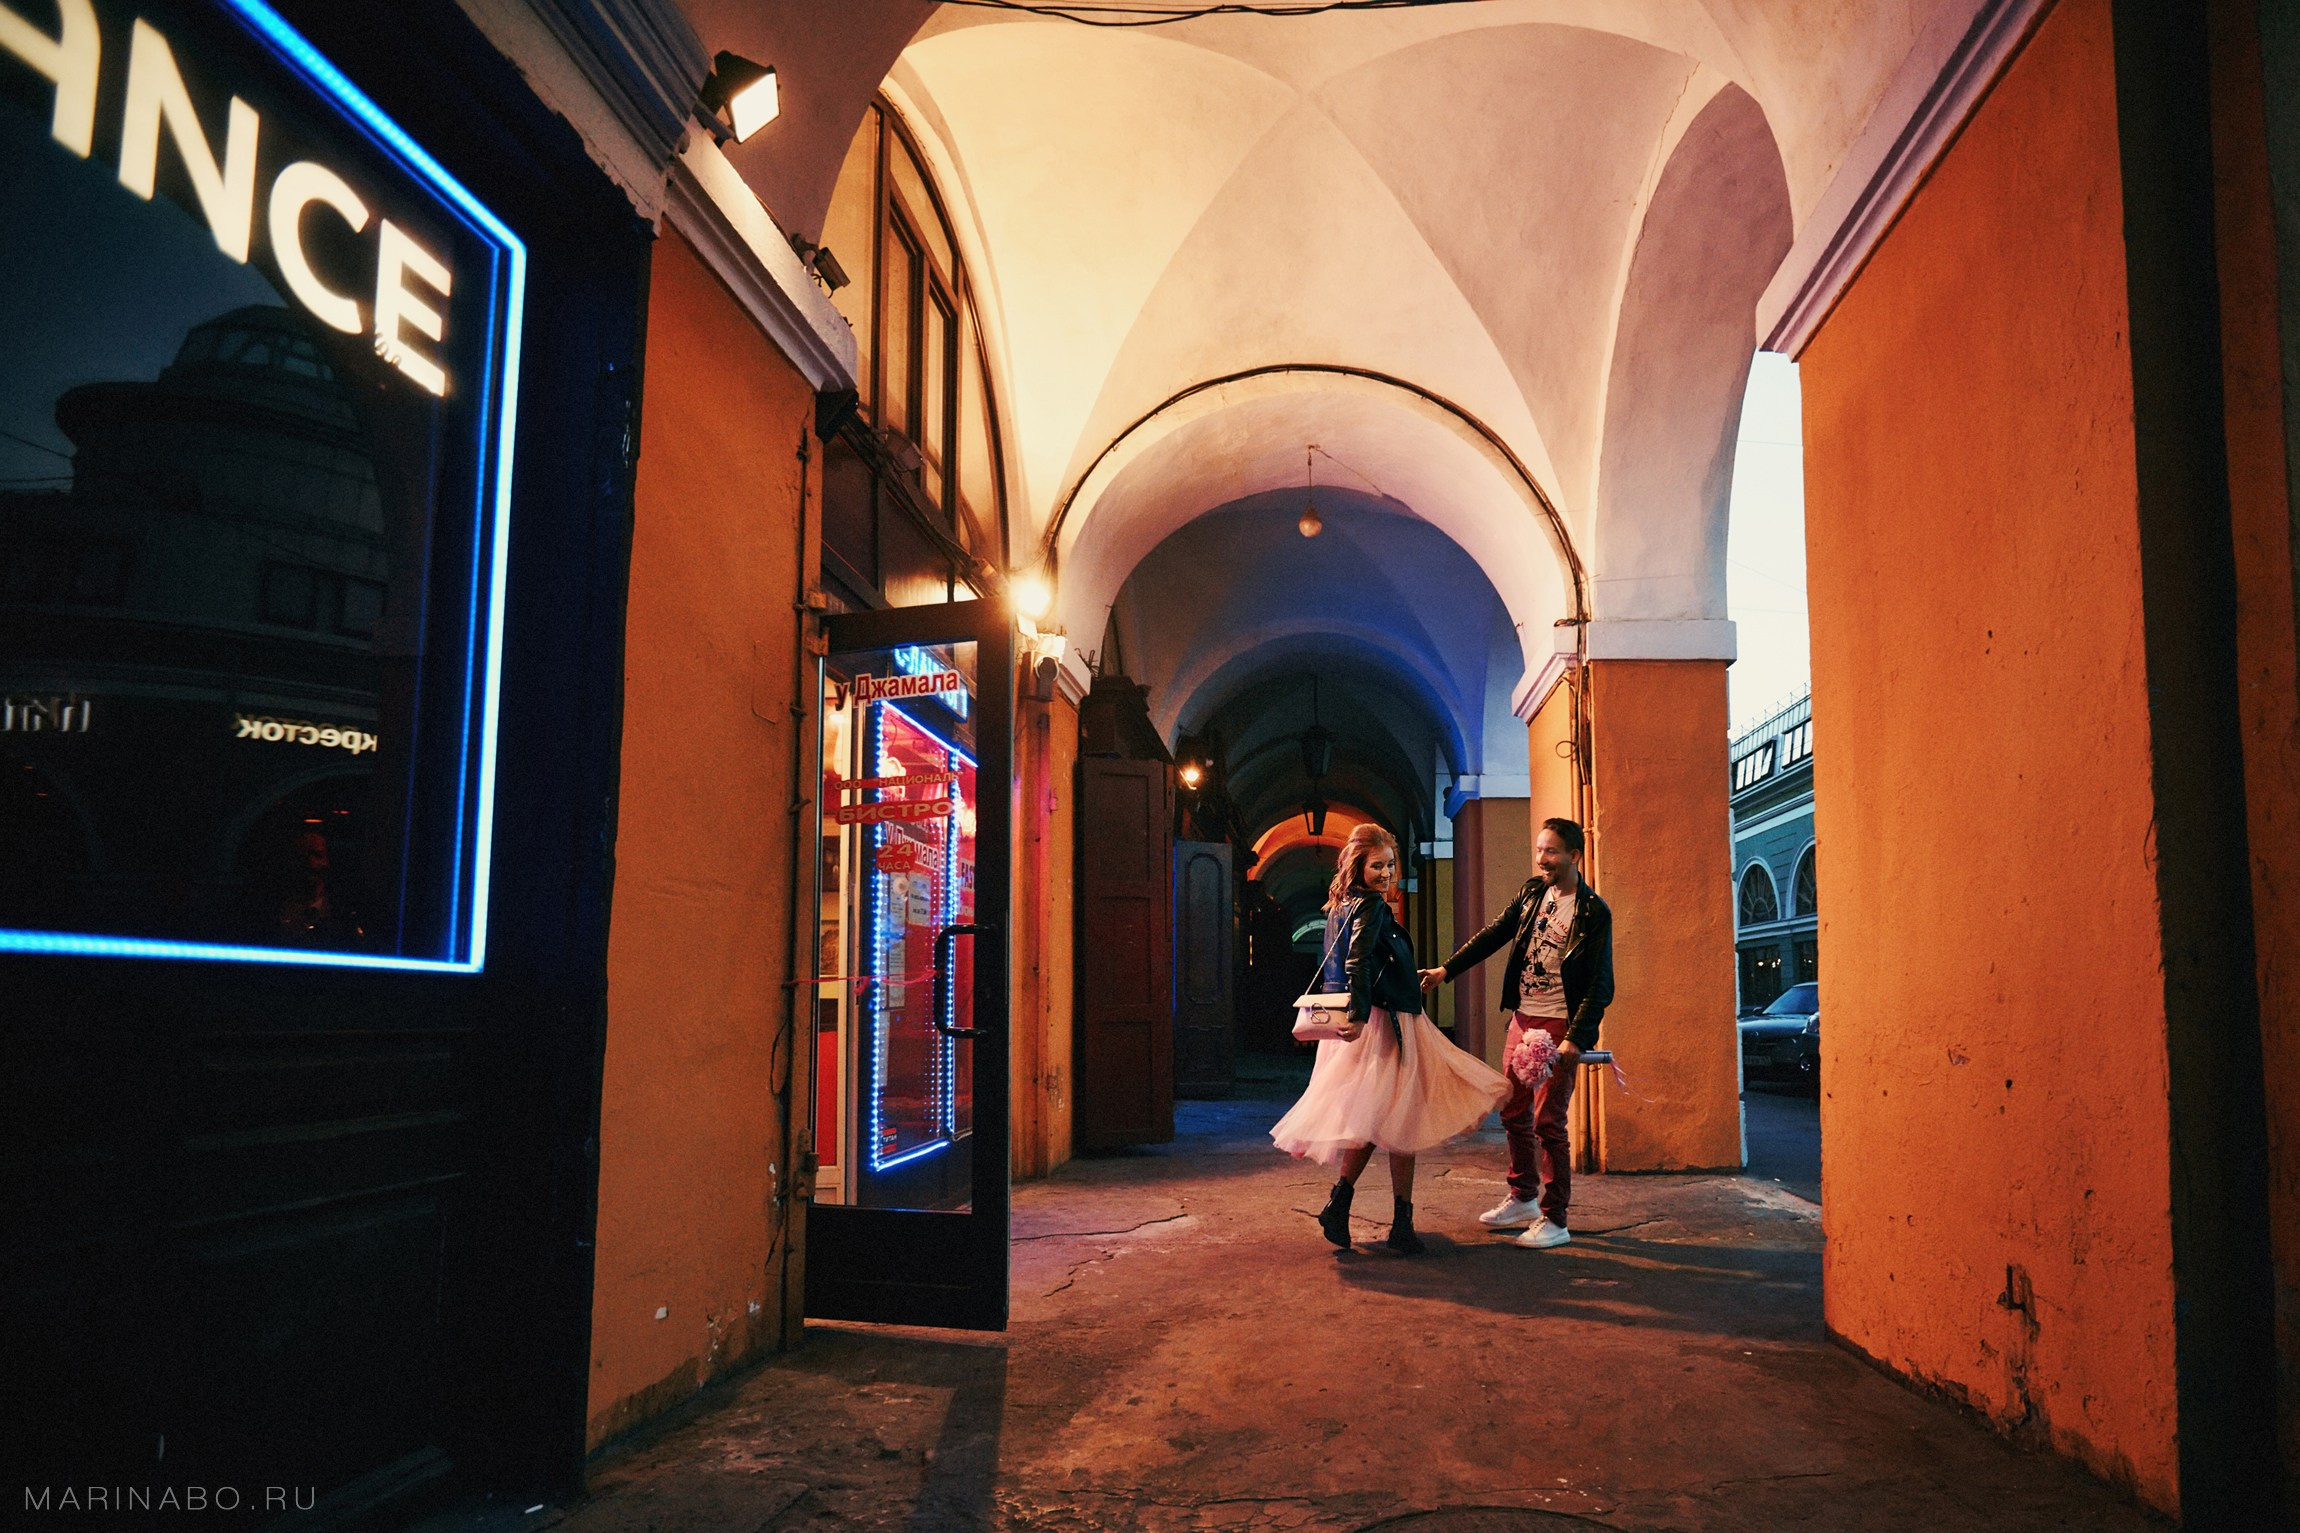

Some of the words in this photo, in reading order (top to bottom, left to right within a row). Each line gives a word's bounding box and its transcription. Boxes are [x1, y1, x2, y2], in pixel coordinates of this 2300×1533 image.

[854, 672, 959, 708] Джамала
[834, 780, 862, 791] ООО
[838, 801, 954, 822] БИСТРО
[878, 843, 913, 859] 24
[878, 860, 911, 871] ЧАСА
